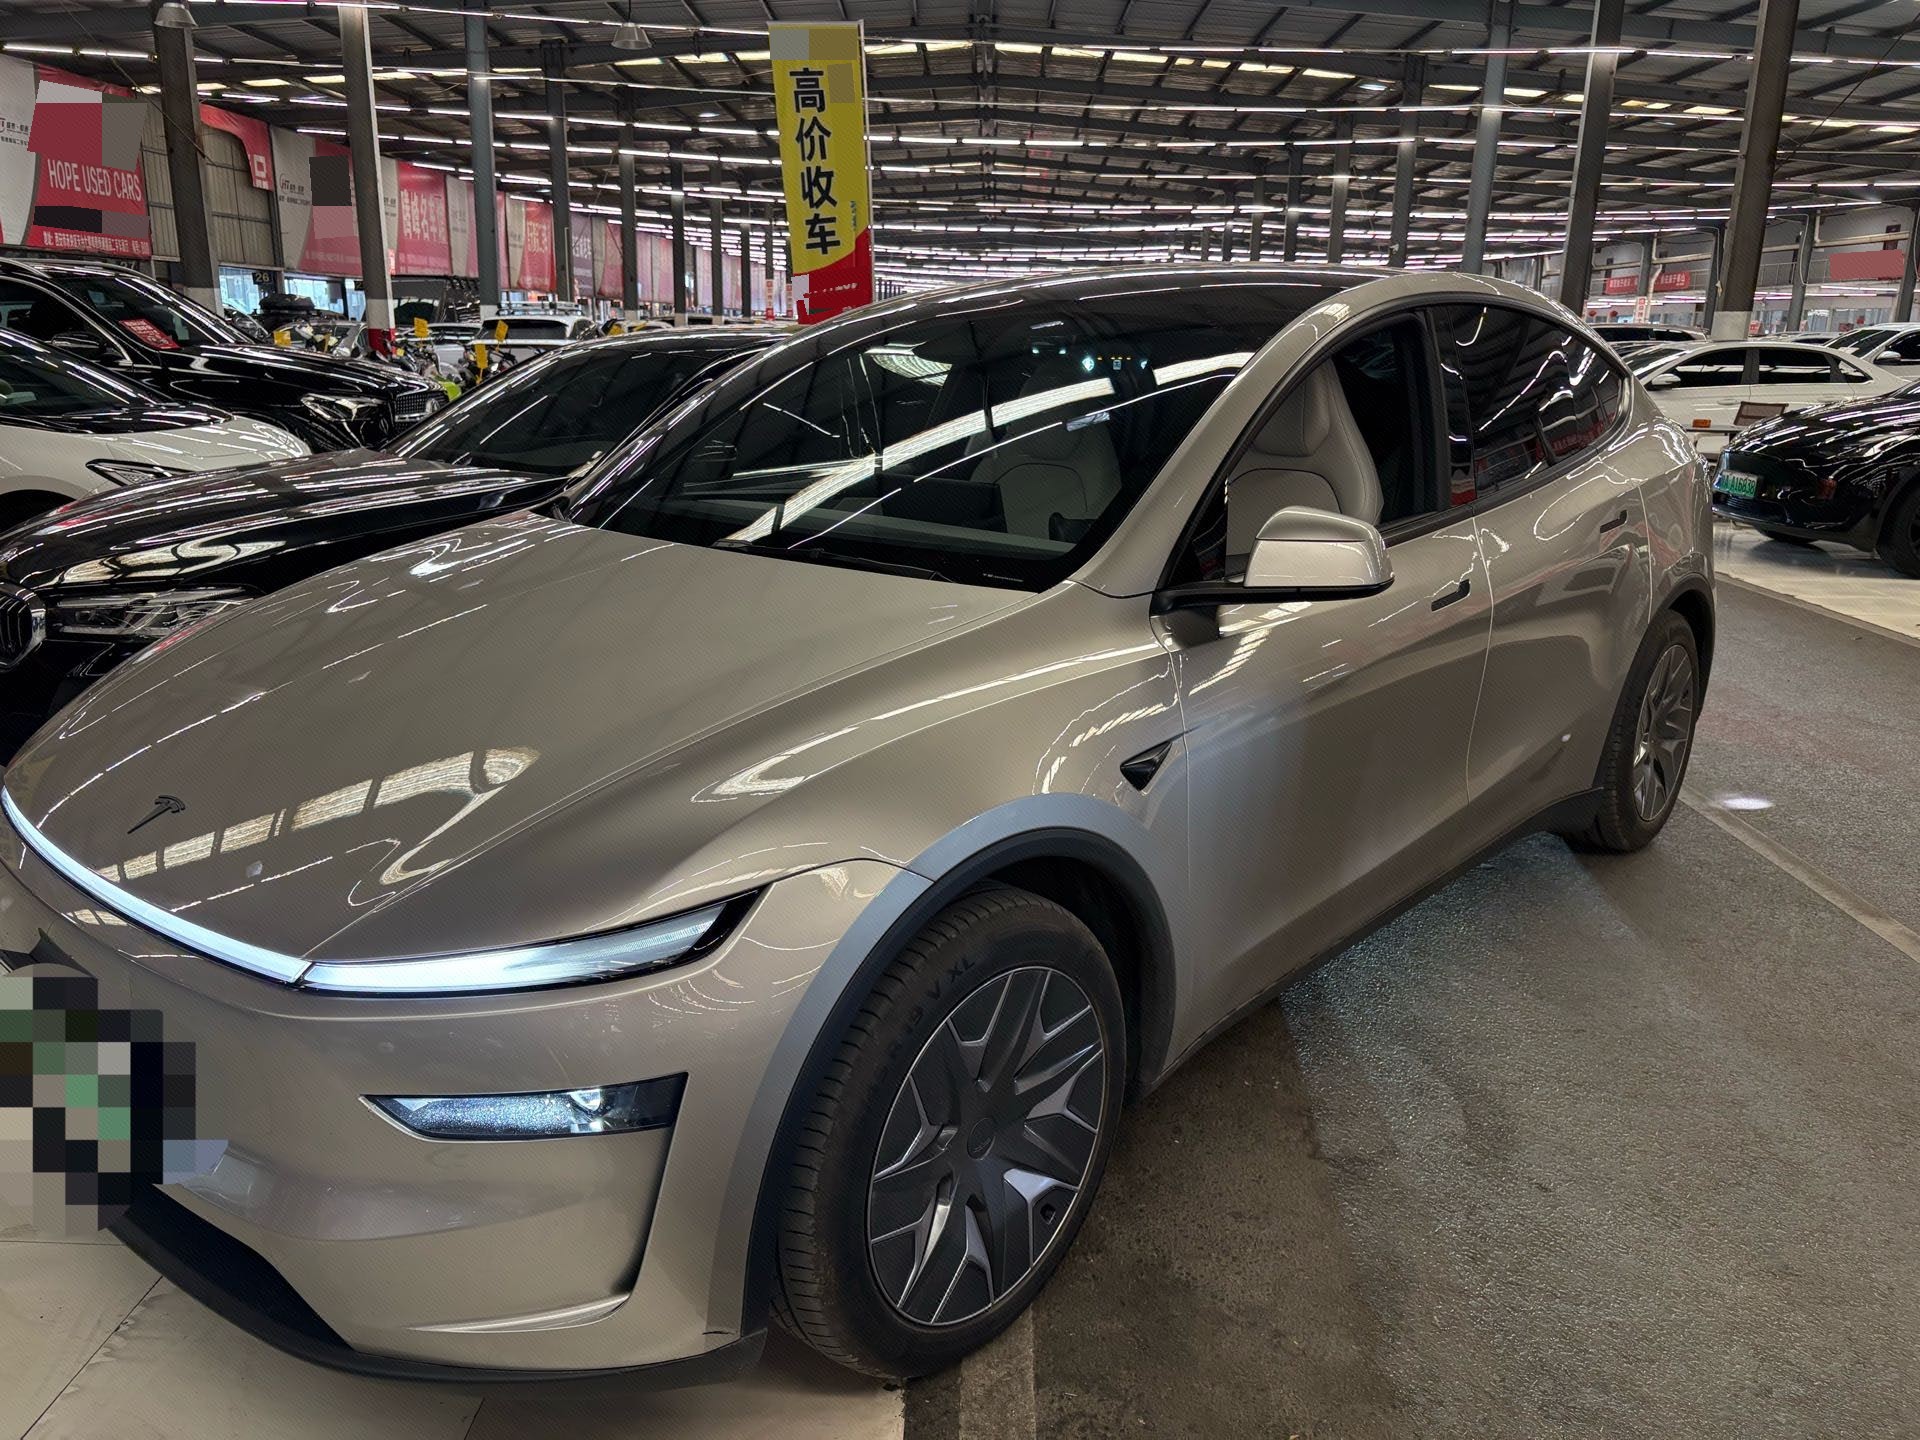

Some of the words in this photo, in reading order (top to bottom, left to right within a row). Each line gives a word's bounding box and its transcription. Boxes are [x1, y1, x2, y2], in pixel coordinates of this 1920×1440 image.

[47, 159, 81, 192] HOPE
[82, 165, 112, 197] USED
[113, 171, 142, 202] CARS
[789, 67, 841, 255] 高价收车
[254, 273, 270, 283] 26
